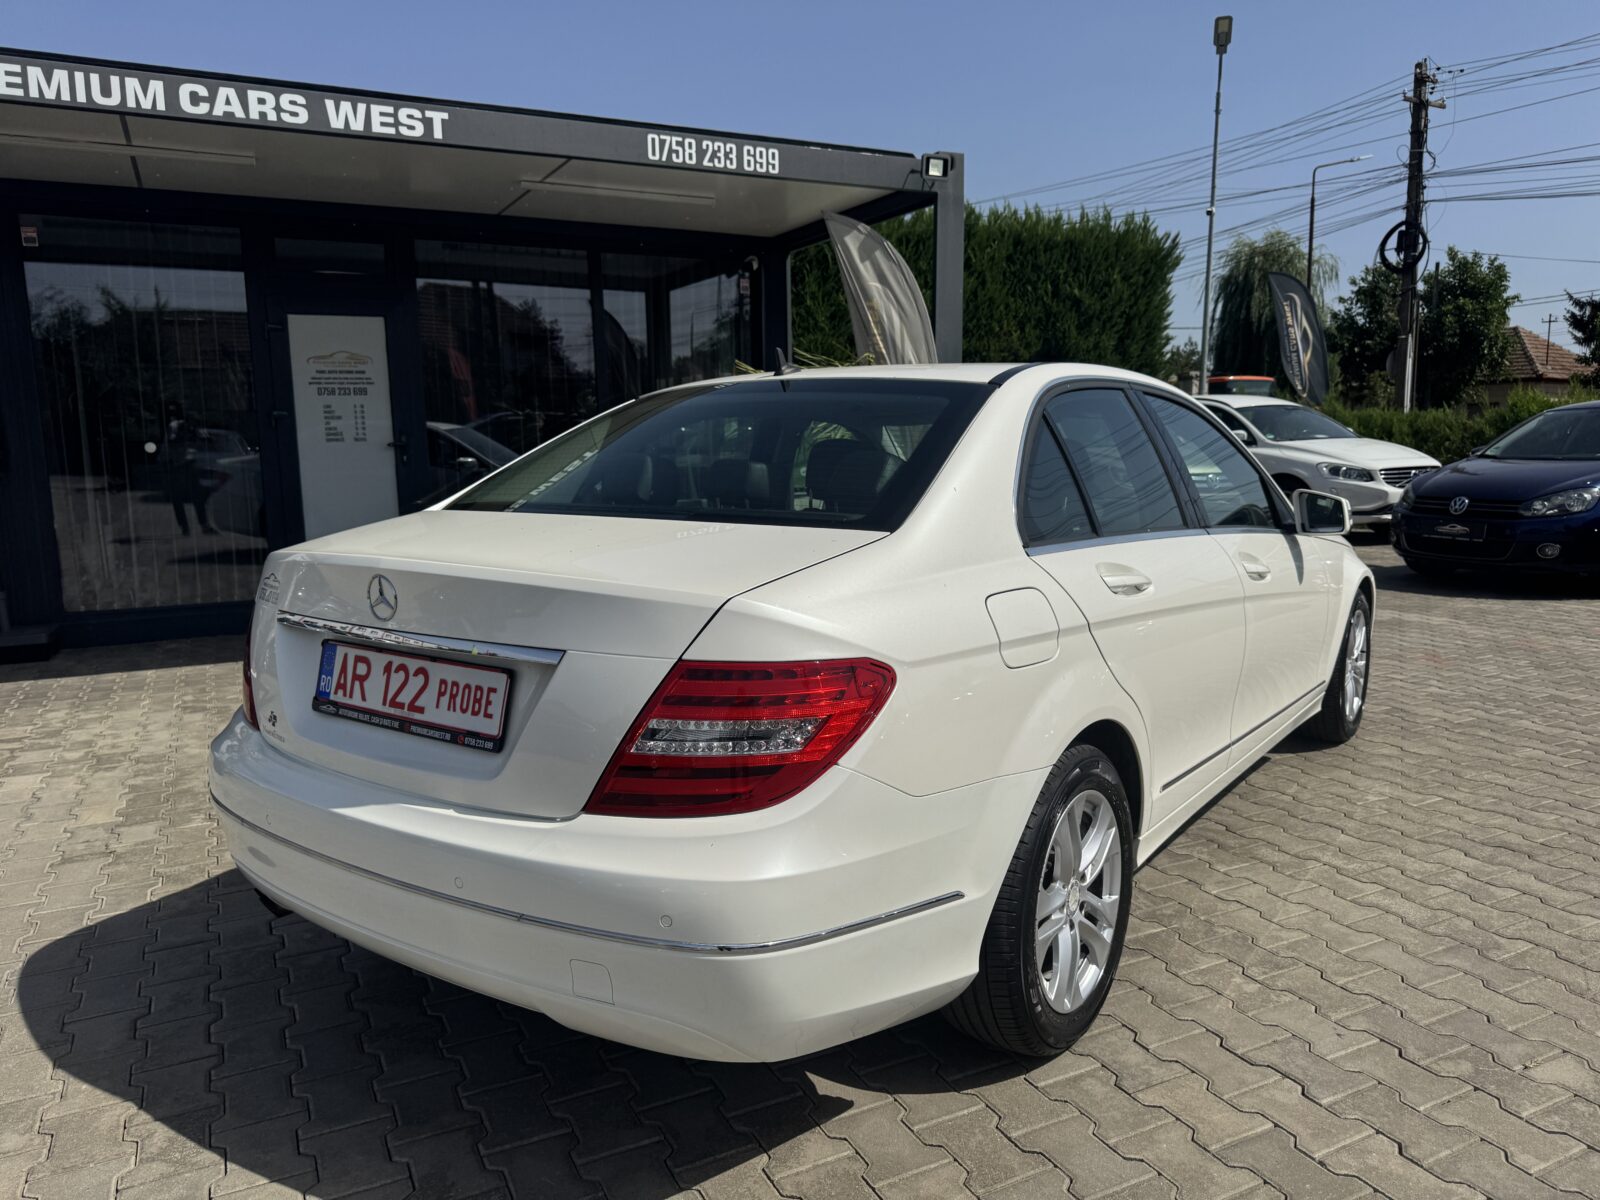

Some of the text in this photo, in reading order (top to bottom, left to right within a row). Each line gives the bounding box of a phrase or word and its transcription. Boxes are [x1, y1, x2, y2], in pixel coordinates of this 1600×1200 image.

[178, 82, 309, 125] CARS
[324, 98, 449, 140] WEST
[647, 133, 780, 175] 0758 233 699
[319, 674, 332, 693] RO
[333, 652, 498, 720] AR 122 PROBE
